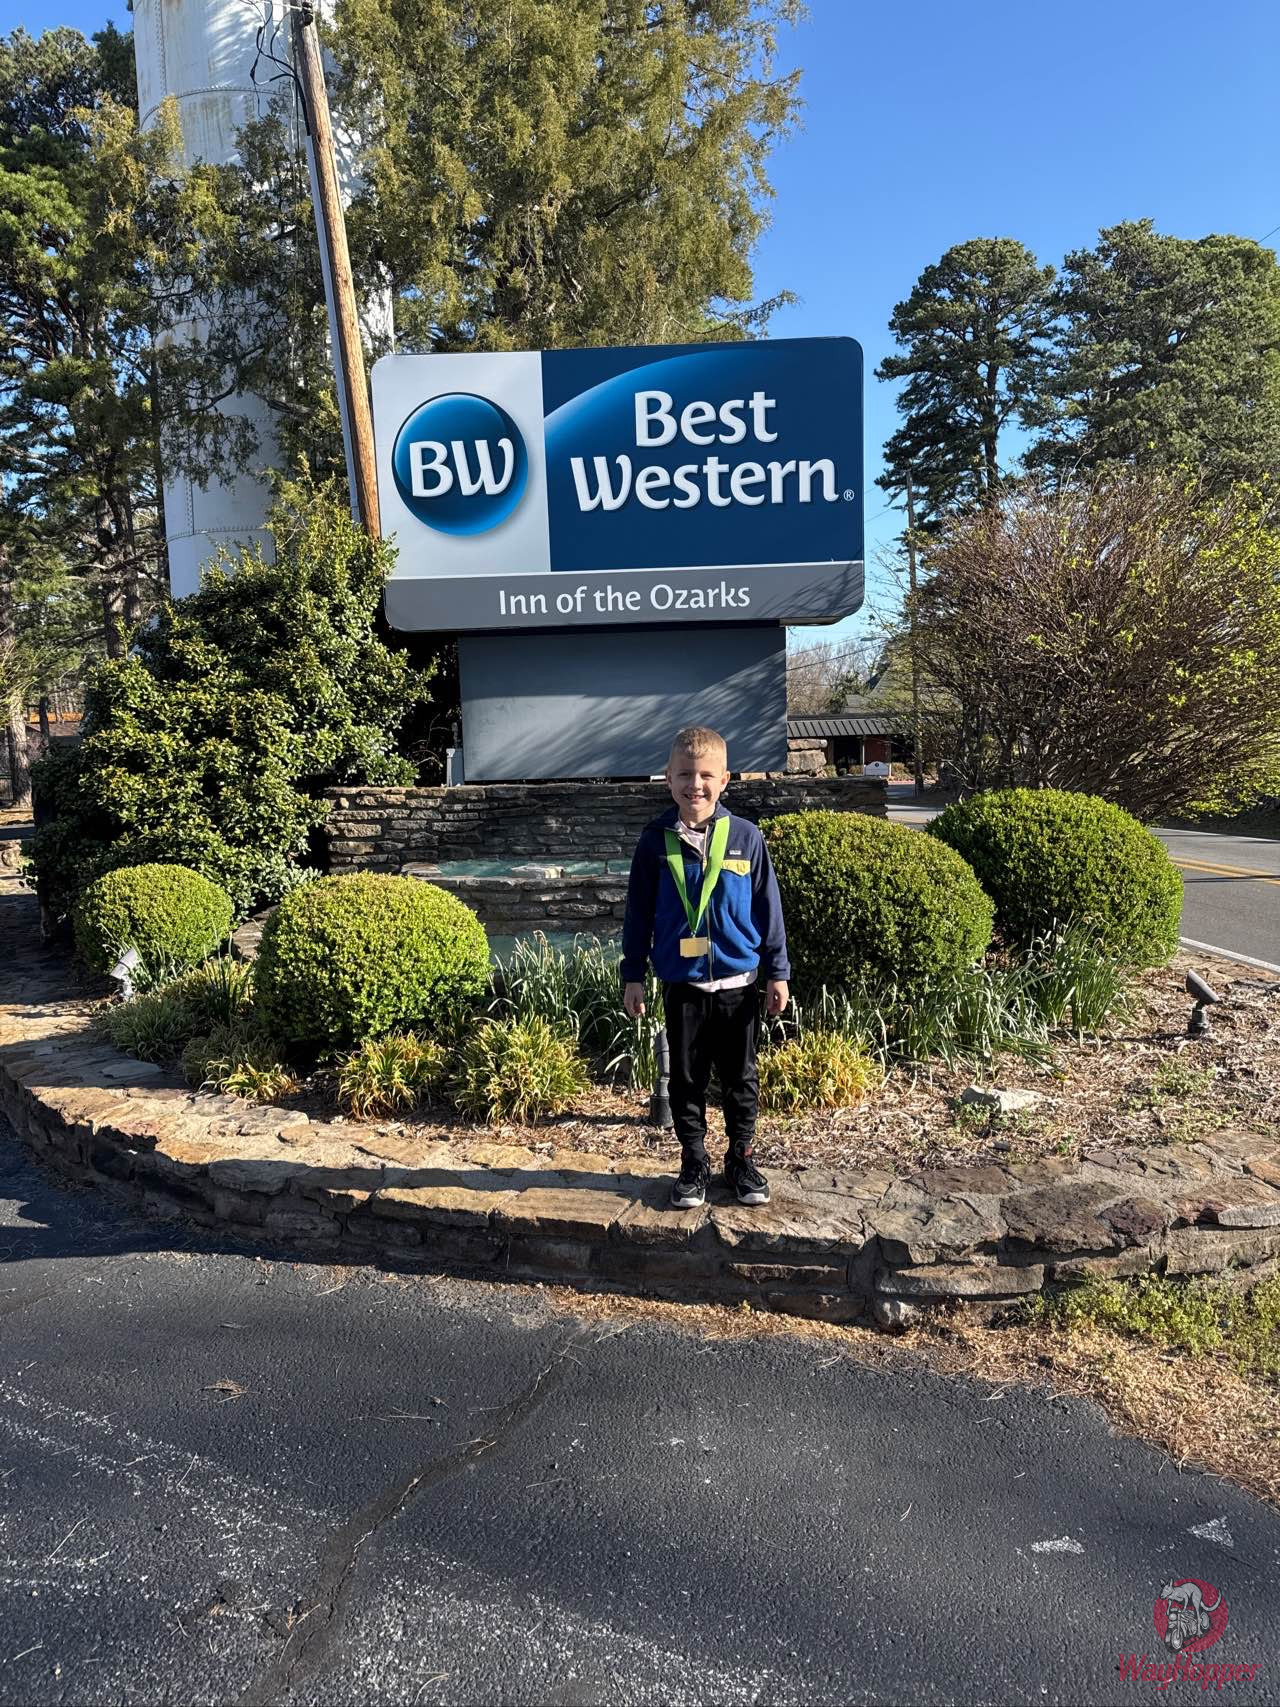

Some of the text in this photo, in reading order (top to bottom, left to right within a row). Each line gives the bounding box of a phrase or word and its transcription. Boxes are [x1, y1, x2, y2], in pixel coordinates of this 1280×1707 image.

[634, 389, 779, 448] Best
[408, 437, 516, 497] BW
[499, 581, 751, 615] Inn of the Ozarks
